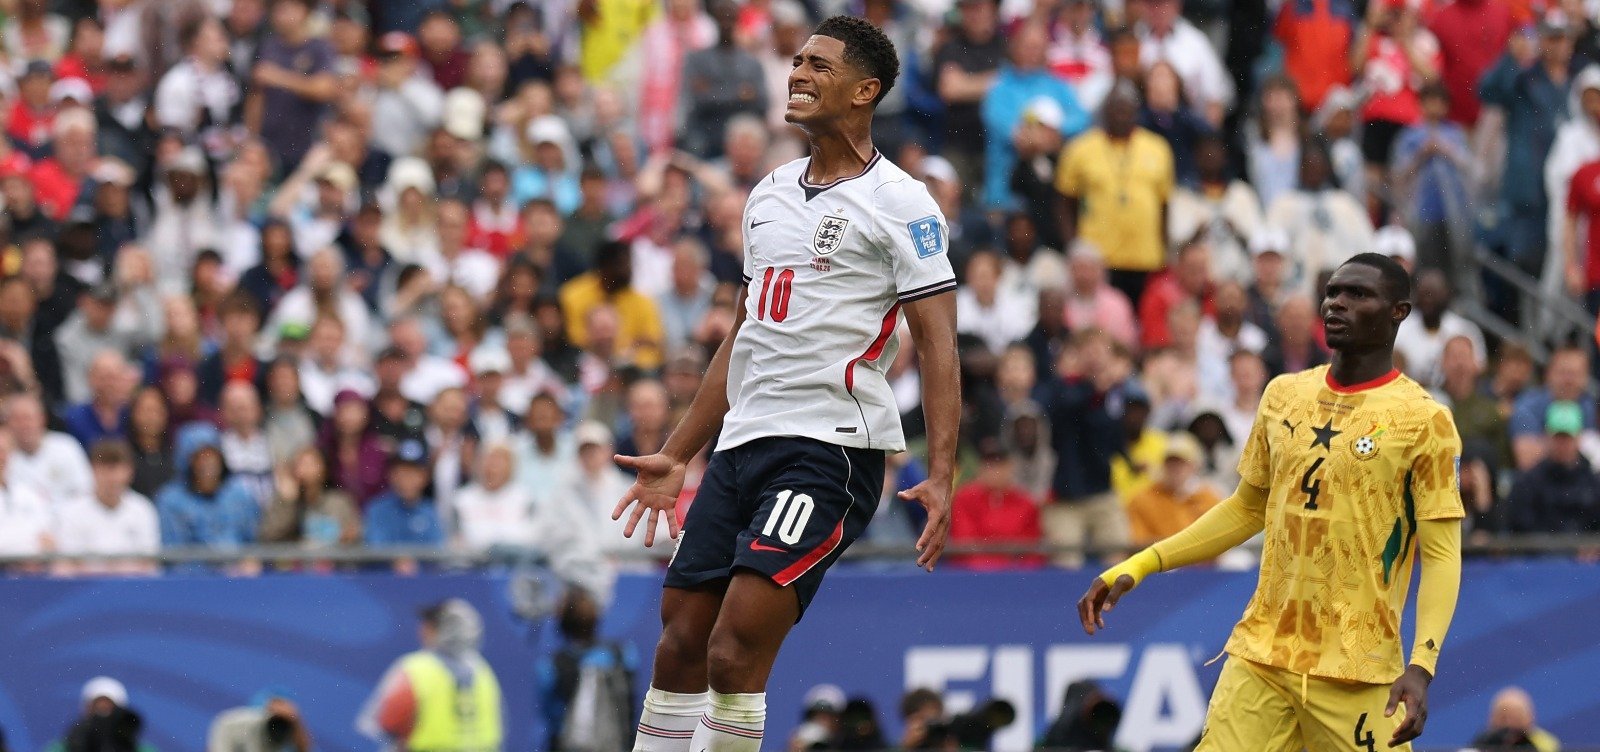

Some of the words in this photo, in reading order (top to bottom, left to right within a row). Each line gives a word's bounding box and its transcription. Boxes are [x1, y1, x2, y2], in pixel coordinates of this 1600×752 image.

[758, 266, 795, 323] 10
[1301, 457, 1325, 510] 4
[761, 489, 815, 545] 10
[904, 645, 1208, 751] FIFA
[1354, 712, 1377, 752] 4
